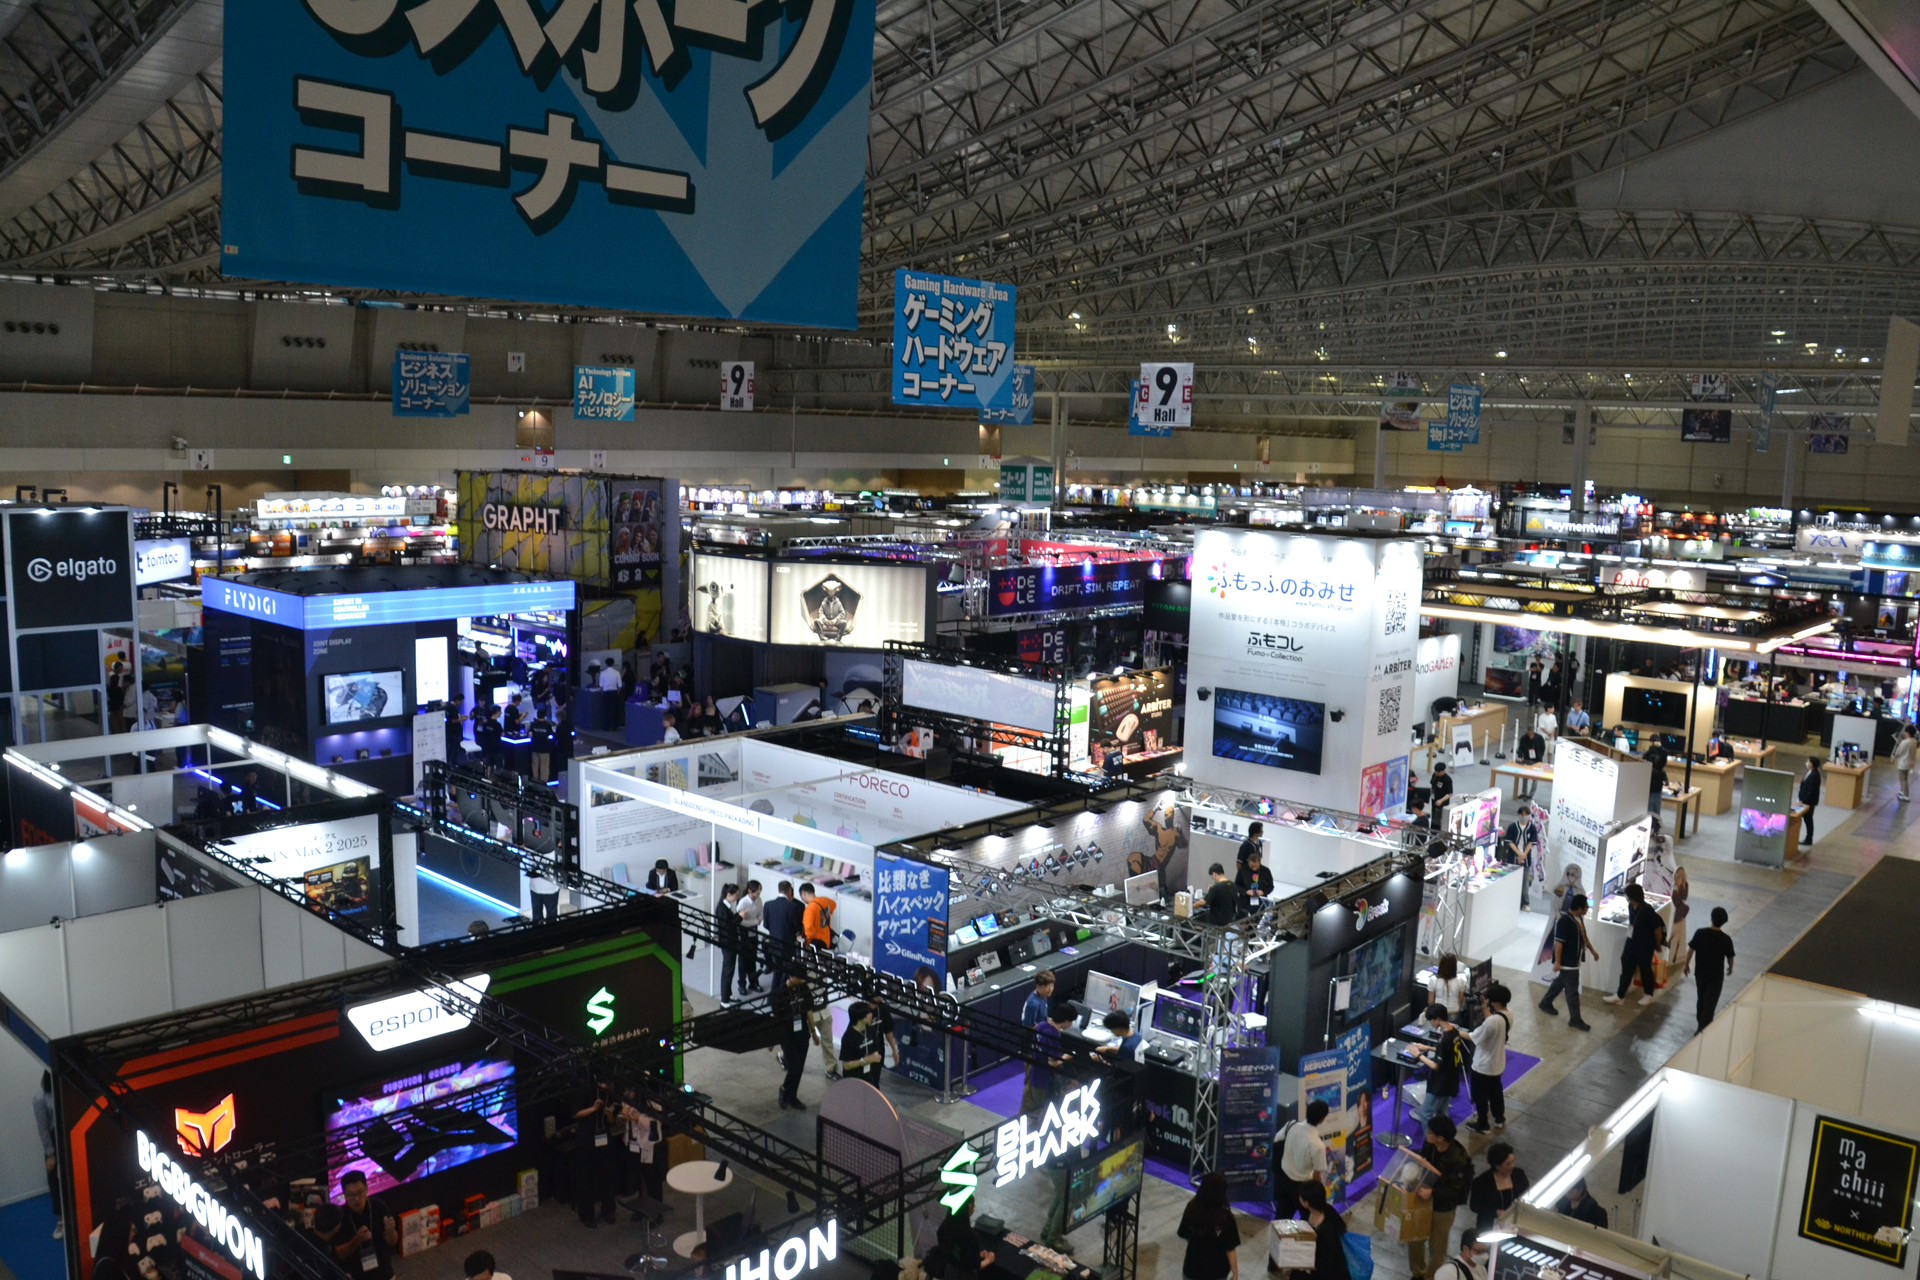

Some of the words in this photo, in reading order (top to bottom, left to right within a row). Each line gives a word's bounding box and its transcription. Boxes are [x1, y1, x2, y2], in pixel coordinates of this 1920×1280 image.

[294, 77, 690, 222] コーナー
[904, 274, 941, 296] Gaming
[943, 278, 987, 299] Hardware
[988, 285, 1009, 301] Area
[902, 292, 993, 338] ゲーミング
[901, 335, 1007, 375] ハードウェア
[400, 361, 453, 379] ビジネス
[400, 379, 466, 397] ソリューション
[578, 375, 593, 390] AI
[731, 364, 746, 395] 9
[902, 372, 976, 400] コーナー
[1156, 367, 1178, 405] 9
[578, 390, 633, 406] テクノロジー
[730, 397, 745, 408] Hall
[1141, 387, 1149, 400] C
[1183, 388, 1191, 400] E
[400, 397, 446, 409] コーナー
[578, 405, 623, 419] パビリオン
[1449, 394, 1473, 412] ビジネス
[983, 408, 1016, 422] コーナー
[1154, 408, 1176, 422] Hall
[1448, 428, 1469, 441] コーナー
[1000, 471, 1025, 486] ニトリ
[263, 503, 311, 513] CAPCOM
[483, 503, 560, 535] GRAPHT
[1544, 518, 1618, 535] Paymentwall
[147, 551, 179, 568] tomtoc
[614, 553, 641, 565] COMING
[642, 552, 660, 562] SOON
[56, 556, 117, 581] elgato
[1051, 584, 1084, 597] DRIFT,
[1085, 583, 1105, 594] SIM,
[1106, 580, 1140, 592] REPEAT
[1217, 571, 1355, 602] ふもっふのおみせ
[225, 588, 276, 615] FLYDIGI
[333, 604, 370, 613] CONTROLLER
[1151, 602, 1175, 611] TITAN
[313, 639, 328, 647] JOINT
[329, 638, 352, 646] DISPLAY
[1247, 631, 1304, 651] ふもコレ
[1246, 648, 1265, 657] Fumo
[1270, 651, 1303, 662] Collection
[1383, 657, 1412, 675] ARBITER
[1140, 697, 1172, 714] ARBITER
[834, 791, 867, 805] CERTIFICATION
[673, 798, 704, 813] GUANGDONG
[704, 806, 724, 819] FORECO
[724, 814, 755, 827] PACKAGING
[325, 841, 333, 854] 2
[336, 834, 368, 852] 2025
[1568, 834, 1597, 858] ARBITER
[877, 869, 932, 894] 比類なき
[876, 890, 945, 916] ハイスペック
[877, 916, 927, 940] アケコン
[996, 1077, 1101, 1158] BLACK
[1163, 1131, 1181, 1145] OUR
[995, 1108, 1101, 1188] SHARK
[1839, 1137, 1867, 1170] ma
[1841, 1170, 1885, 1199] chiii
[136, 1129, 266, 1280] BIGBIGWON
